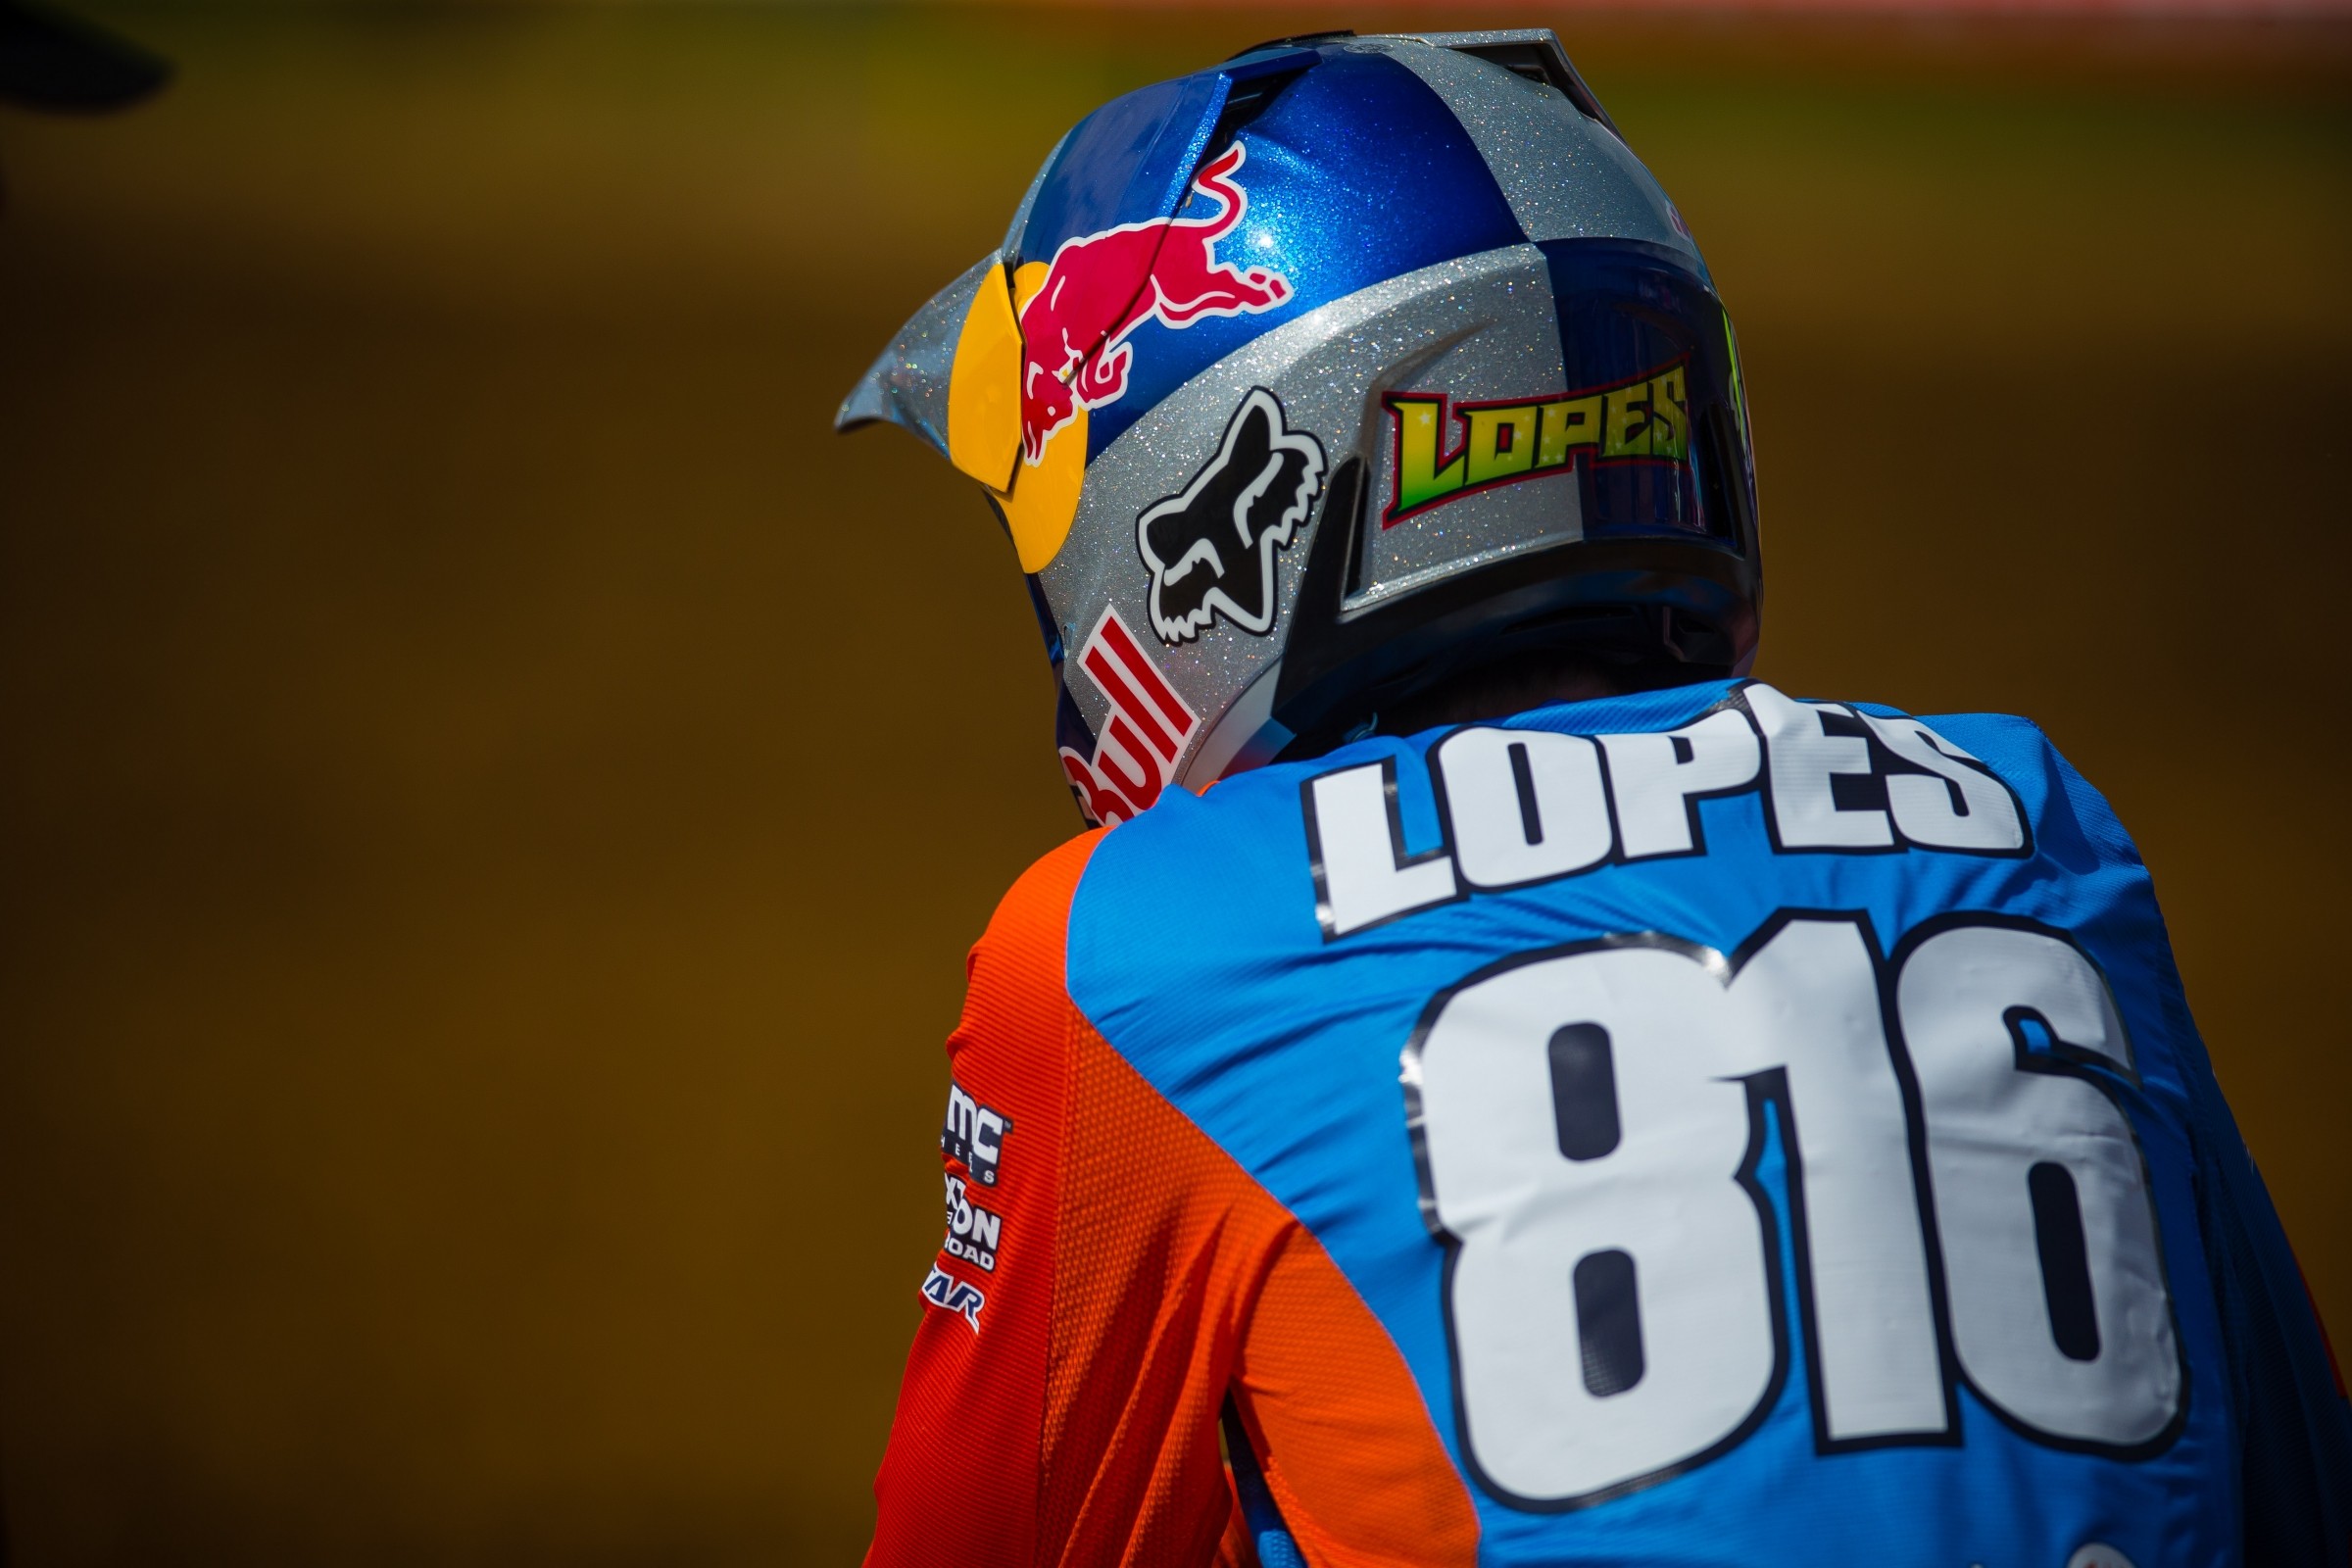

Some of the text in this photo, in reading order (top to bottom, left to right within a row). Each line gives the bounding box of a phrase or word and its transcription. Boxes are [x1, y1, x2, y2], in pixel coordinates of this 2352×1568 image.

[1388, 364, 1689, 514] LOPES
[1311, 682, 2025, 937] LOPES
[924, 1267, 982, 1329] AR
[1416, 918, 2185, 1503] 816
